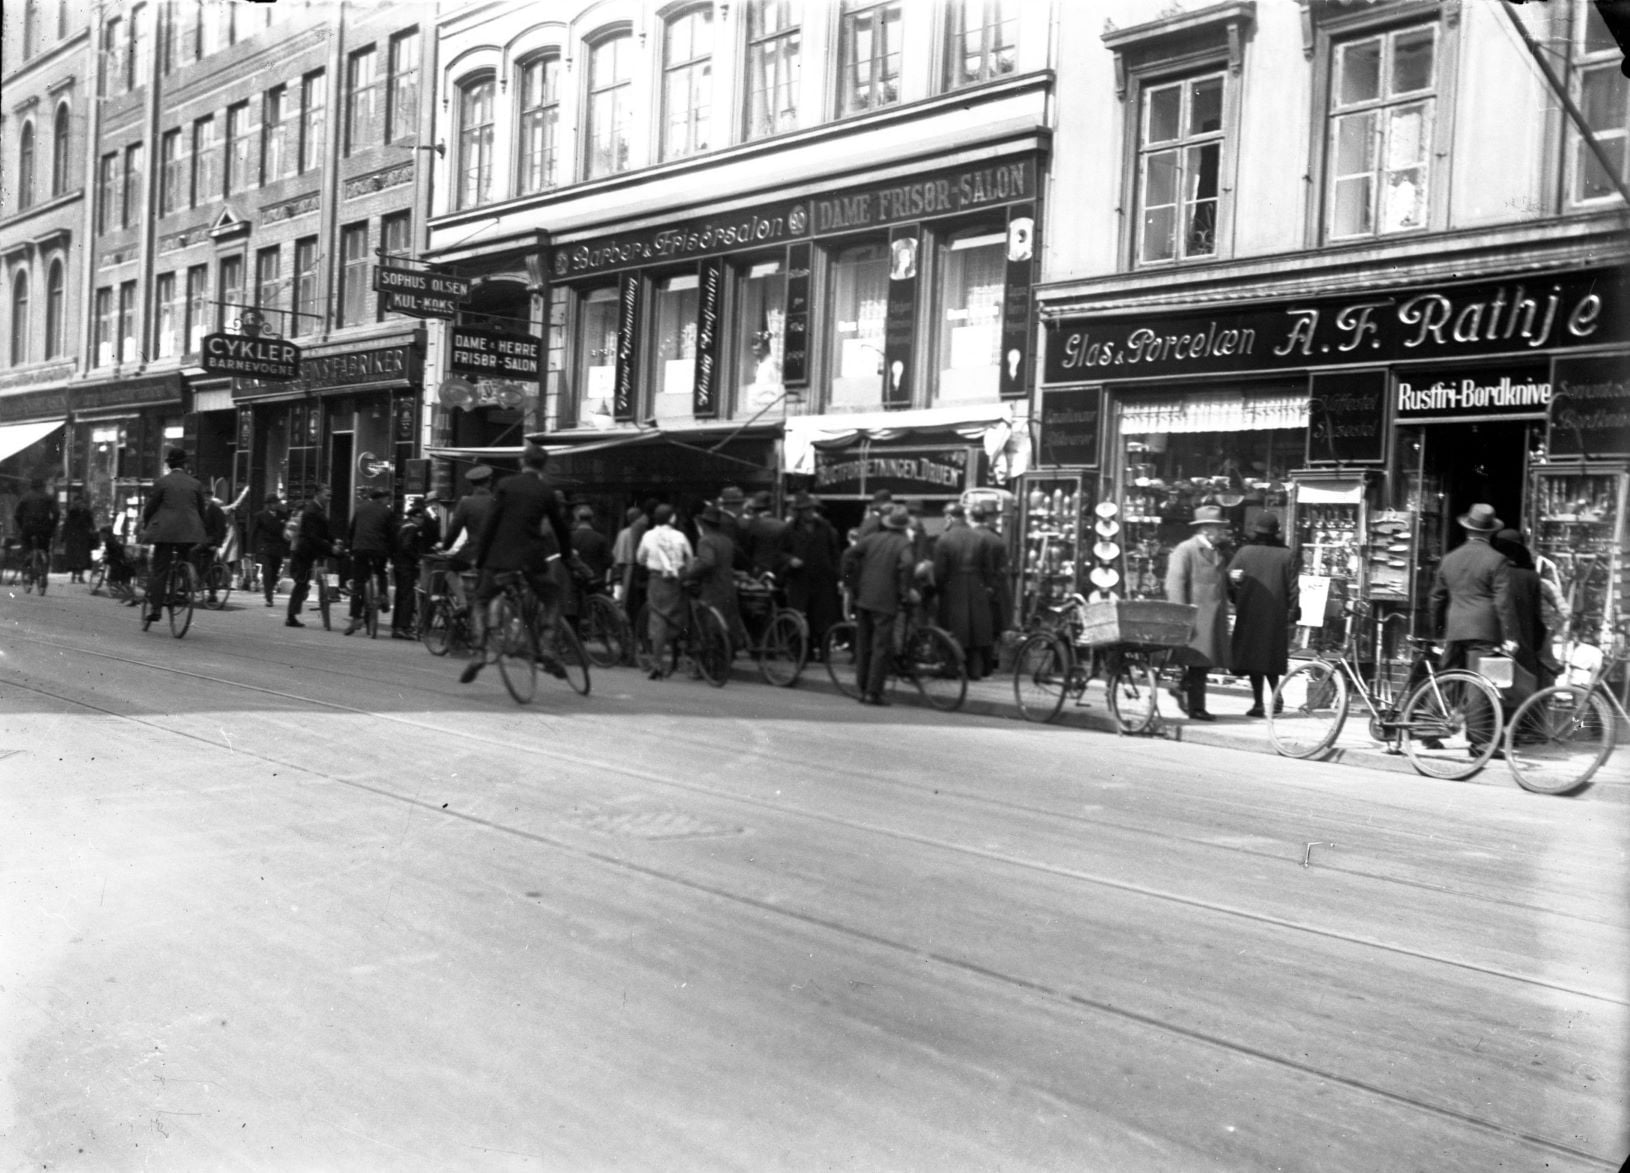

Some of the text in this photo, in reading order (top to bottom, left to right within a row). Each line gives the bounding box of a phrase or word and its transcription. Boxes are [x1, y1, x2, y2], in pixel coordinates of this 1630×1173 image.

[820, 194, 871, 231] DAME
[573, 240, 642, 270] Barber
[381, 271, 468, 296] SOPHUS OLSEN
[1398, 284, 1601, 348] Rathje
[208, 337, 296, 363] CYKLER
[455, 334, 488, 350] DAME
[498, 340, 538, 357] HERRE
[1062, 321, 1256, 368] Glas & Porcelæn
[208, 357, 295, 377] BARNEVOGNE
[1398, 377, 1551, 411] Rustfri-Bordknive
